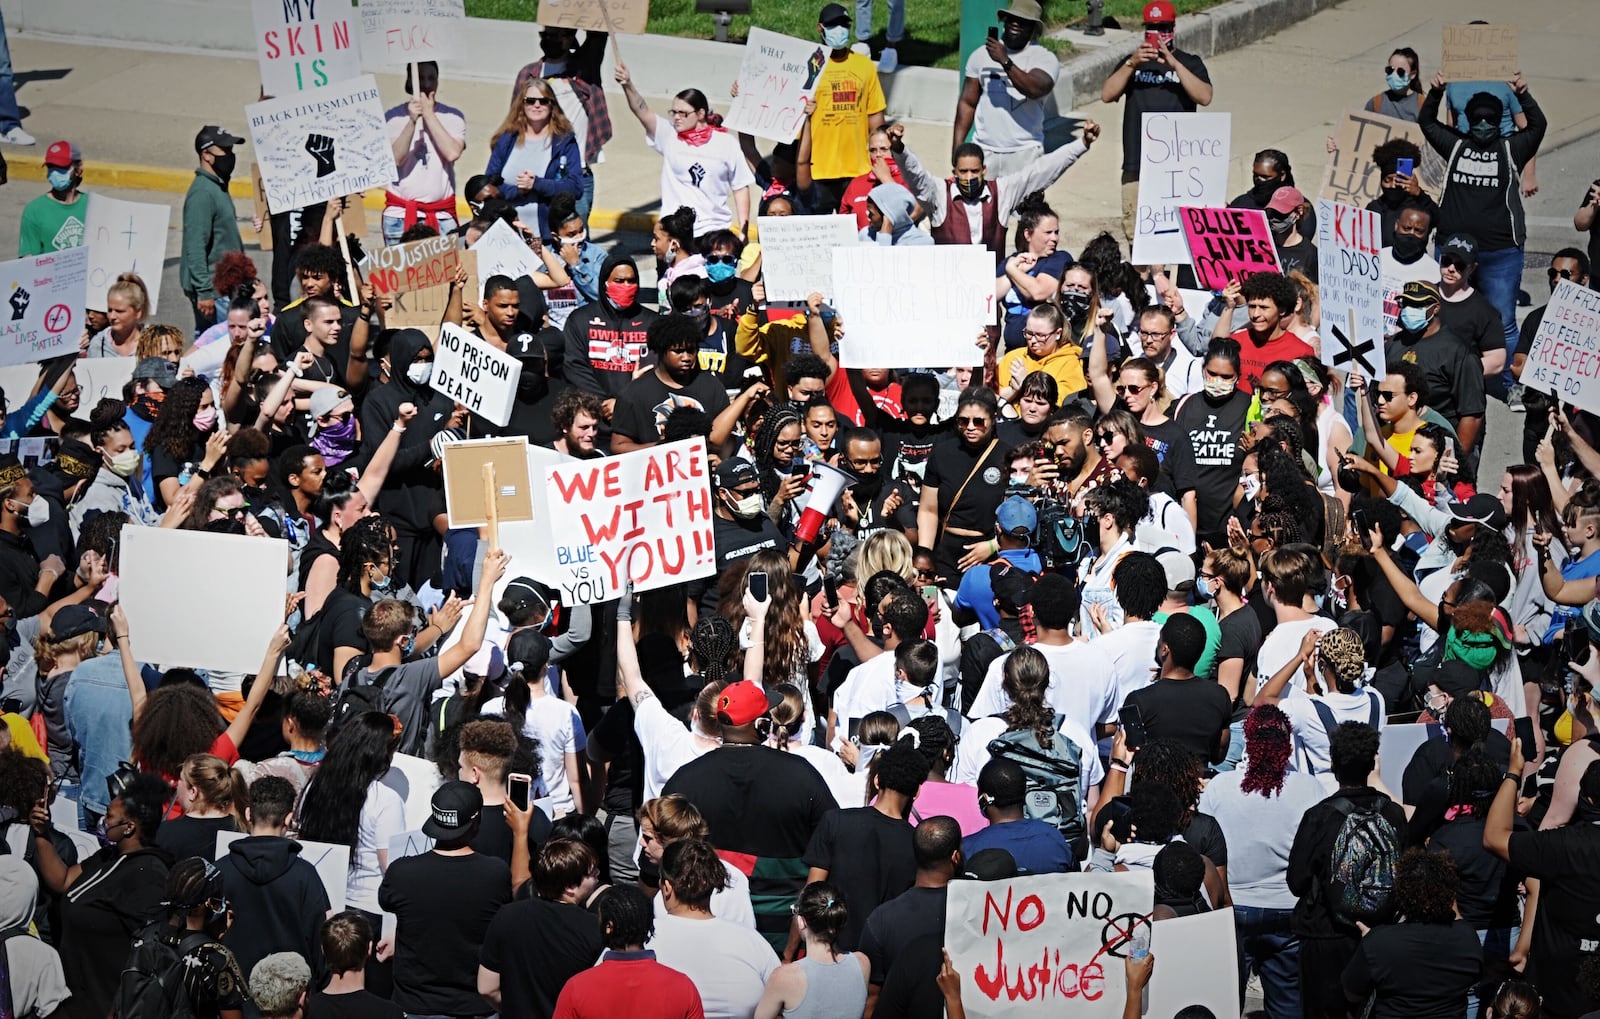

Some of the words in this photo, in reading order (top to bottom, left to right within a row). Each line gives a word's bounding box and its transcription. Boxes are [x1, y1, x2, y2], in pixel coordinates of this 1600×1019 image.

[264, 20, 350, 59] SKIN
[385, 25, 434, 55] FUCK
[760, 45, 785, 60] WHAT
[295, 59, 328, 90] IS
[781, 62, 806, 75] ABOUT
[763, 74, 790, 95] MY
[252, 108, 292, 127] BLACK
[1146, 114, 1222, 163] Silence
[1463, 147, 1498, 160] BLACK
[268, 188, 297, 211] Say
[298, 179, 336, 199] their
[1161, 167, 1204, 199] IS
[1453, 173, 1499, 187] MATTER
[1188, 207, 1252, 237] BLUE
[367, 245, 393, 270] NO
[1204, 236, 1276, 266] LIVES
[1341, 248, 1380, 281] DADS
[369, 267, 399, 294] NO
[406, 249, 459, 292] PEACE!
[1553, 282, 1575, 300] MY
[0, 322, 21, 336] LACK
[15, 330, 38, 345] LIVES
[31, 334, 63, 352] MATTER
[440, 329, 460, 353] NO
[621, 331, 647, 342] THE
[1543, 320, 1556, 335] TO
[1557, 325, 1581, 346] FEEL
[1583, 335, 1595, 350] AS
[460, 360, 480, 383] NO
[1533, 367, 1547, 382] AS
[1549, 371, 1560, 386] I
[1564, 377, 1581, 395] DO
[437, 369, 483, 411] DEATH
[1206, 414, 1217, 428] I
[550, 461, 622, 504] WE
[644, 444, 704, 492] ARE
[580, 487, 711, 546] WITH
[557, 544, 598, 565] BLUE
[599, 528, 714, 591] YOU!!
[562, 575, 605, 605] YOU
[983, 885, 1045, 937] NO
[1067, 890, 1113, 920] NO
[974, 935, 1105, 1002] Justice
